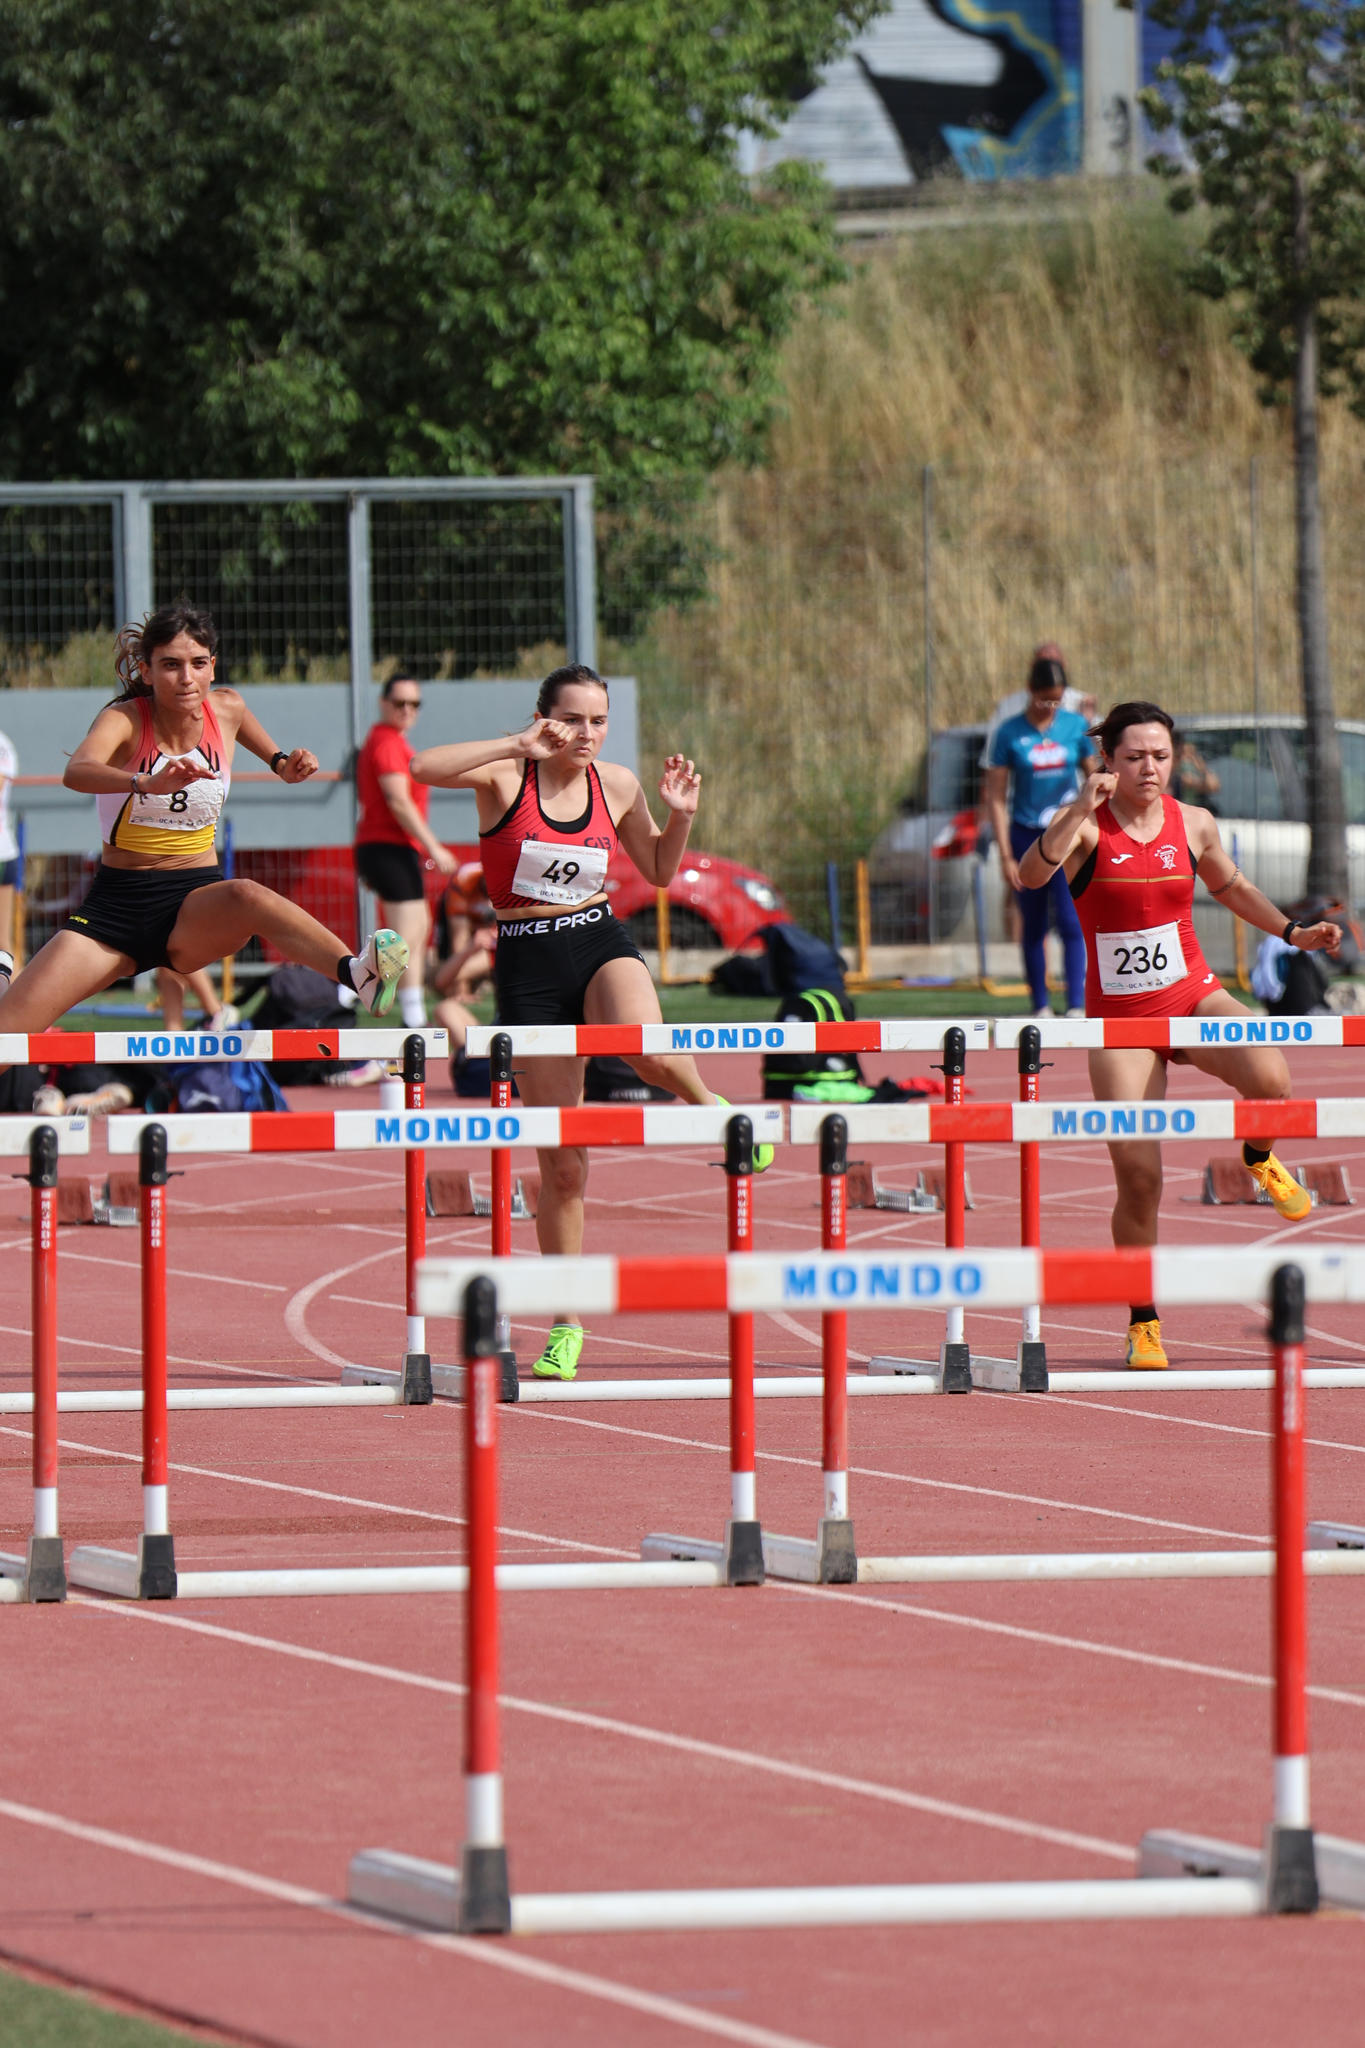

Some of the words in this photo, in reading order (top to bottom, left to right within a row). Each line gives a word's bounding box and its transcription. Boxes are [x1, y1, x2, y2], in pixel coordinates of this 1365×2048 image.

[169, 789, 189, 813] 8
[541, 860, 580, 885] 49
[500, 919, 551, 937] NIKE
[554, 908, 603, 932] PRO
[1113, 942, 1168, 976] 236
[672, 1027, 784, 1049] MONDO
[1200, 1021, 1312, 1043] MONDO
[127, 1036, 243, 1057] MONDO
[375, 1115, 520, 1143] MONDO
[1052, 1108, 1196, 1135] MONDO
[785, 1262, 982, 1299] MONDO
